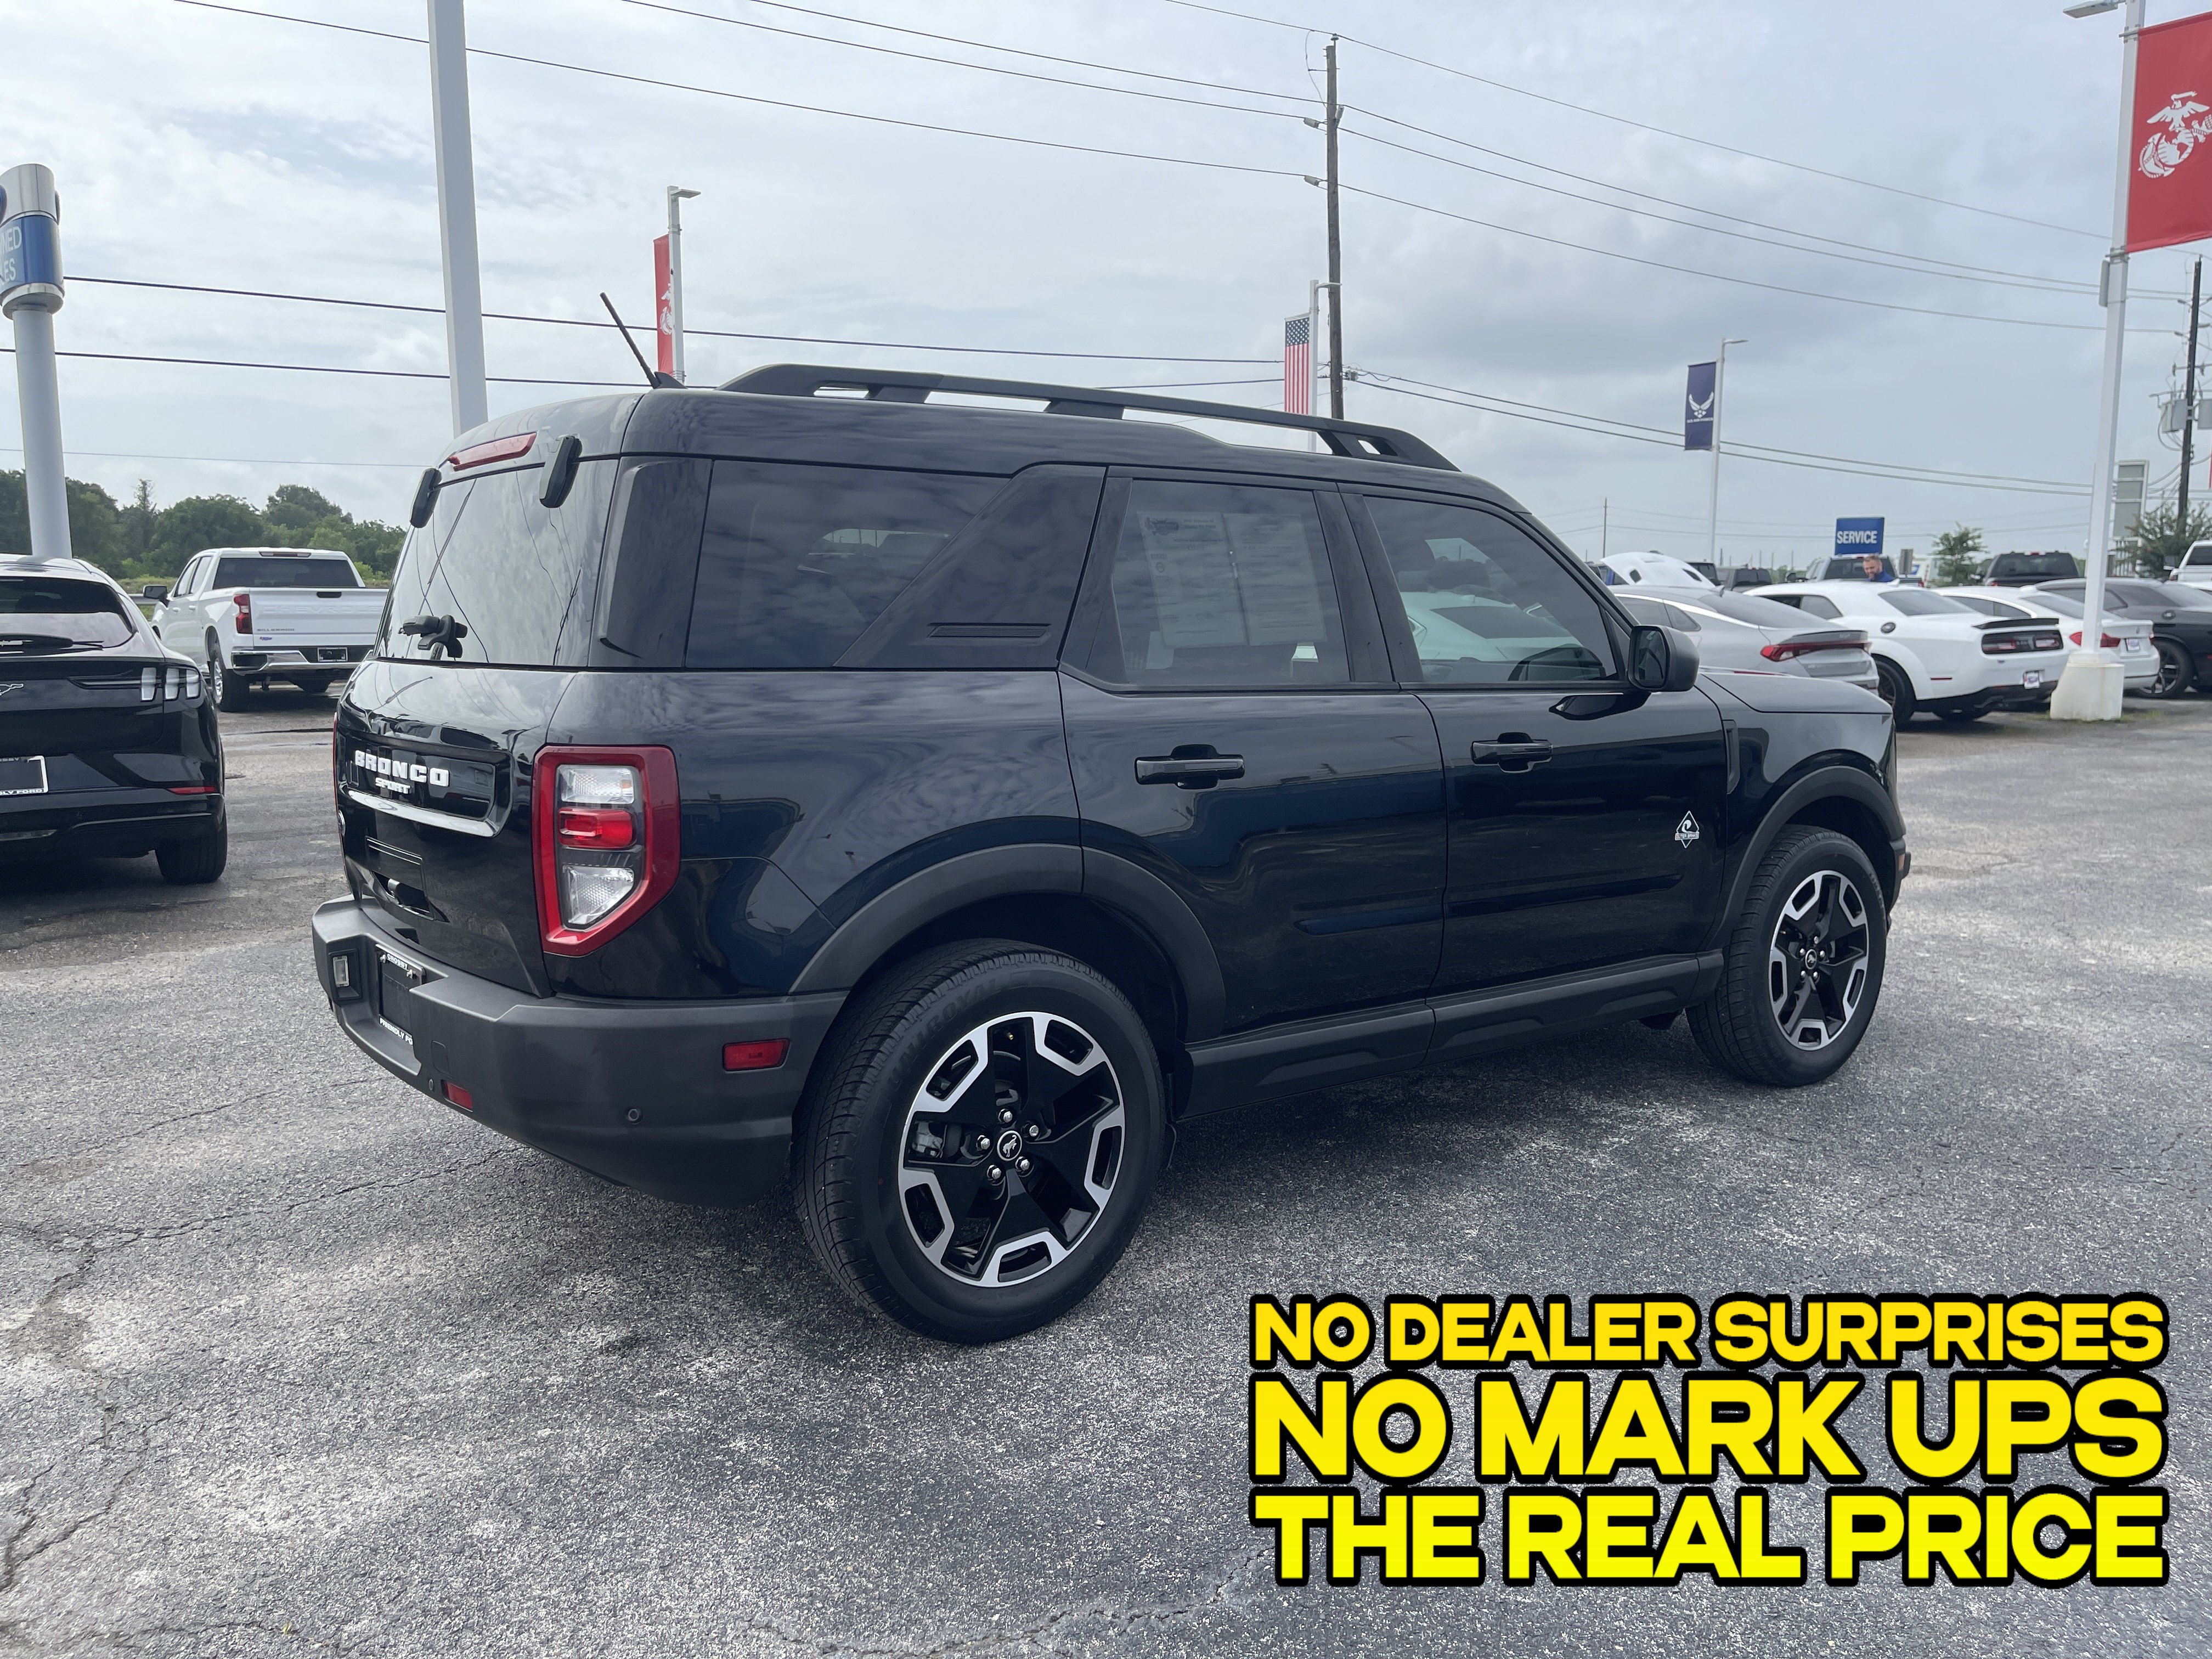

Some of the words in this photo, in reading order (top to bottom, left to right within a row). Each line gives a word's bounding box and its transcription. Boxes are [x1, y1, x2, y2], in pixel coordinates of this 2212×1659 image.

[0, 226, 22, 254] NED
[0, 257, 16, 284] ES
[1837, 531, 1877, 544] SERVICE
[355, 749, 449, 787] BRONCO
[375, 777, 411, 794] SPORT
[387, 953, 409, 970] CROSBY
[380, 1017, 405, 1040] FRIENDLY
[405, 1035, 413, 1045] FO
